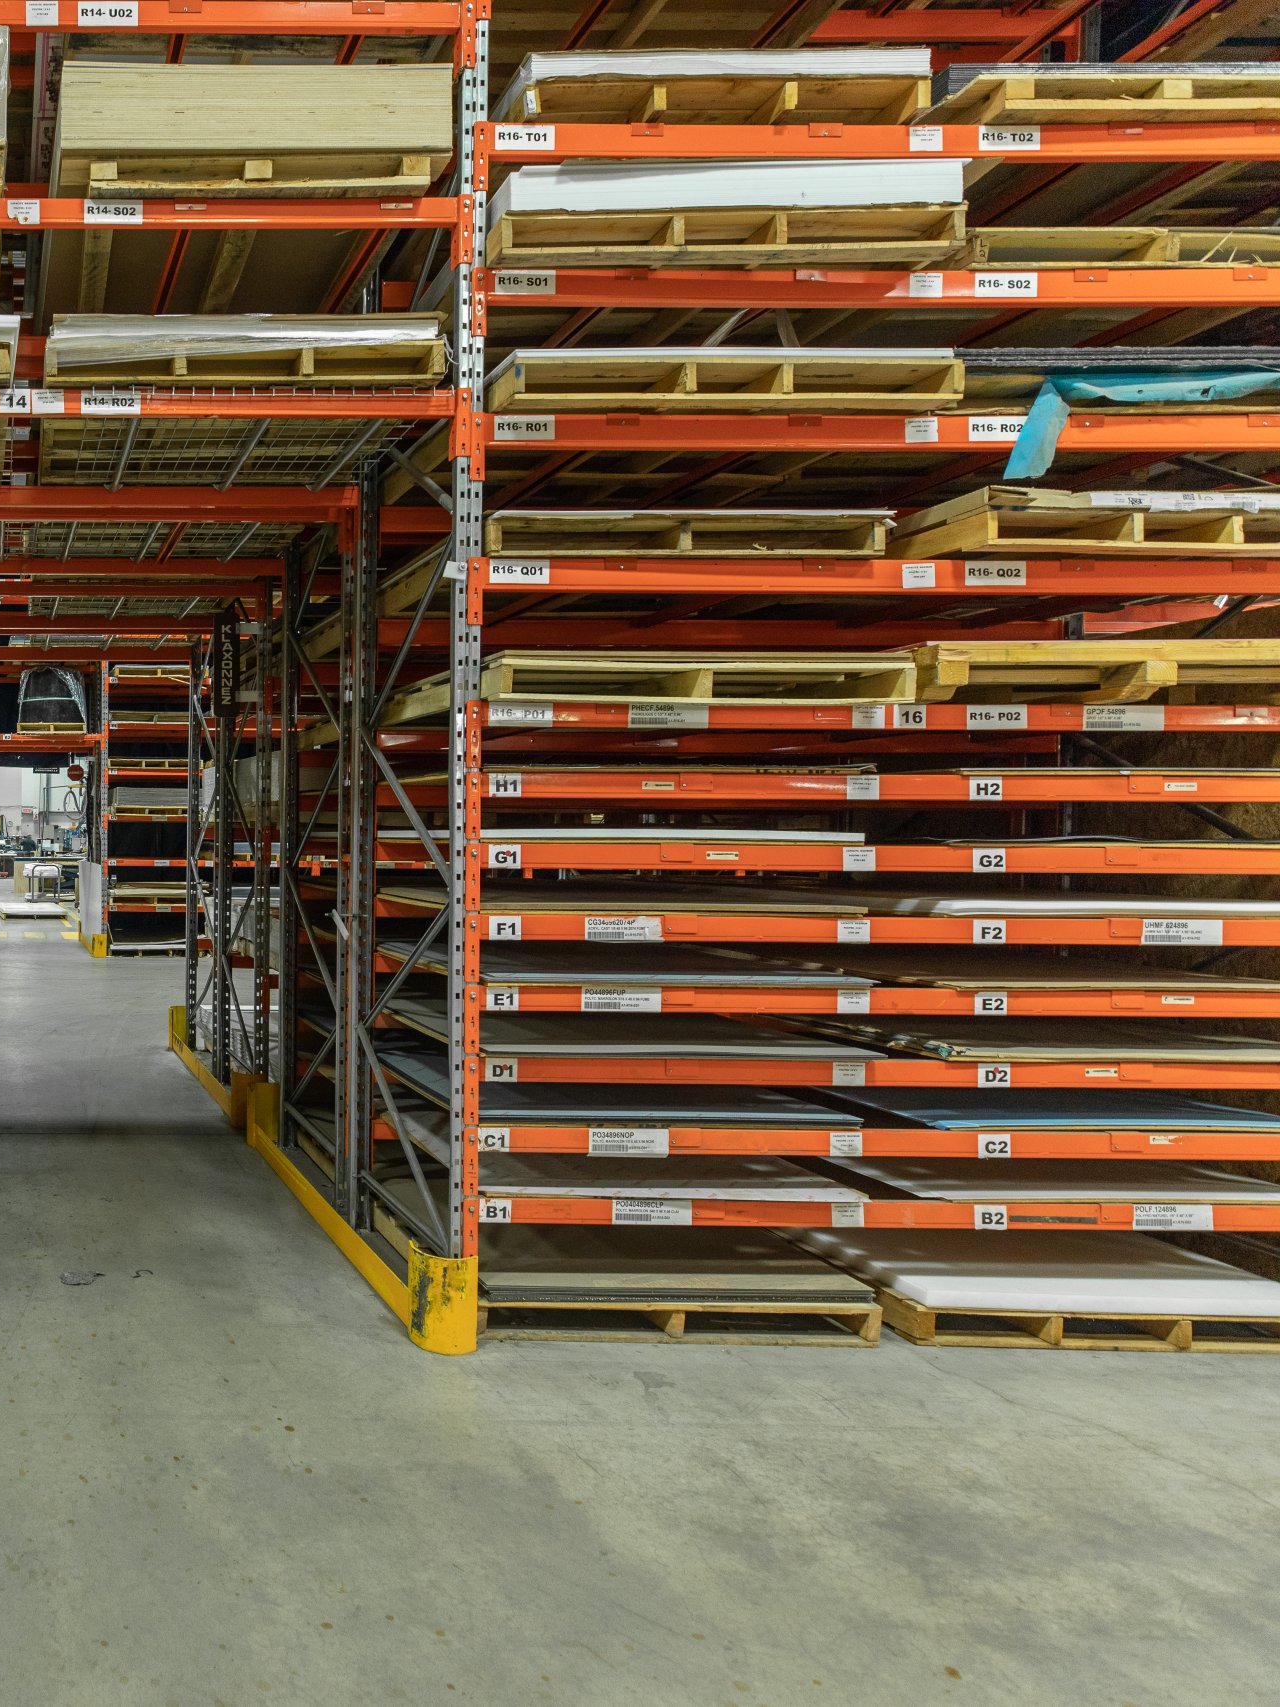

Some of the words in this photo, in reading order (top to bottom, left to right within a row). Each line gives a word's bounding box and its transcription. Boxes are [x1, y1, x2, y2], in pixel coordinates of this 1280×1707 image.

[82, 8, 106, 16] R14-
[109, 9, 132, 18] U02
[498, 132, 523, 140] R16-
[526, 133, 546, 142] T01
[982, 133, 1007, 141] R16-
[1010, 133, 1033, 142] T02
[87, 206, 111, 214] R14-
[114, 207, 136, 216] S02
[498, 277, 523, 285] R16-
[527, 277, 548, 286] S01
[979, 280, 1003, 288] R16-
[1008, 280, 1030, 289] S02
[6, 395, 27, 408] 14
[84, 398, 108, 406] R14-
[112, 398, 135, 407] R02
[498, 422, 522, 430] R16-
[526, 423, 547, 432] R01
[972, 424, 997, 432] R16-
[1001, 424, 1023, 432] R02
[493, 566, 517, 574] R16-
[520, 566, 543, 576] Q01
[968, 568, 993, 576] R16-
[997, 568, 1021, 578] Q02
[222, 624, 233, 704] KLAXONNEZ
[902, 711, 923, 724] 16
[970, 712, 994, 720] R16-
[998, 712, 1020, 721] P02
[496, 780, 518, 792] H1
[977, 783, 1000, 796] H2
[495, 850, 516, 864] G1
[979, 855, 1004, 868] G2
[497, 923, 516, 936] F1
[982, 927, 1002, 940] F2
[494, 994, 514, 1006] E1
[982, 998, 1004, 1010] E2
[492, 1064, 513, 1078] D1
[985, 1070, 1008, 1082] D2
[484, 1134, 506, 1148] C1
[985, 1141, 1008, 1154] C2
[486, 1206, 507, 1219] B1
[982, 1212, 1004, 1225] B2
